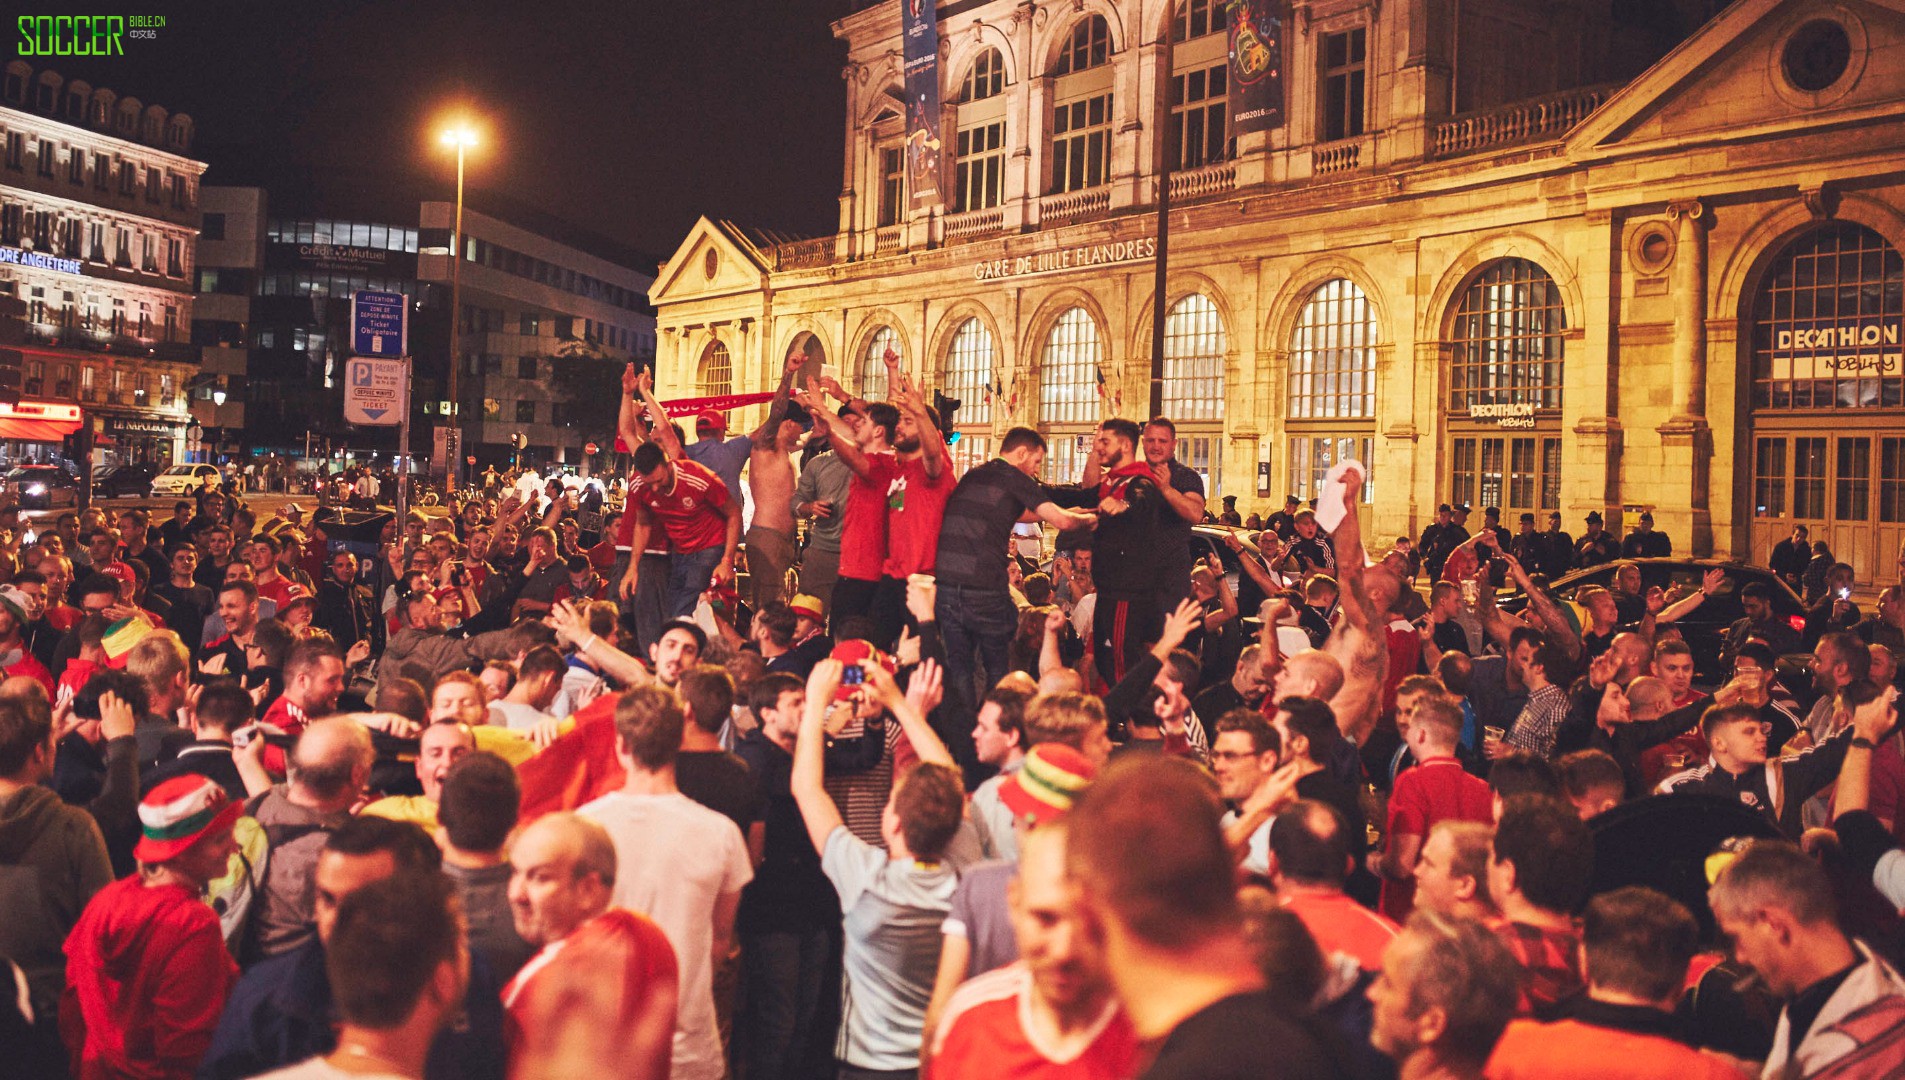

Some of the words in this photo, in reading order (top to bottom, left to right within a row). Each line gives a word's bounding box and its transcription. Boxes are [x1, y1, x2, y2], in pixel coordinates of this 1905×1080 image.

[300, 245, 333, 256] Crédit
[348, 248, 385, 260] Mutuel
[974, 260, 1009, 281] GARE
[1016, 256, 1032, 275] DE
[1038, 249, 1070, 272] LILLE
[1076, 237, 1156, 266] FLANDRES
[20, 252, 81, 275] ANGLETERRE
[360, 326, 398, 337] Obligatoire
[370, 320, 390, 328] Ticket
[1778, 324, 1898, 350] DECATHLON
[356, 364, 369, 384] P
[363, 401, 388, 409] TICKET
[1470, 402, 1533, 417] DECATHLON
[113, 420, 124, 430] LE
[362, 558, 373, 578] P
